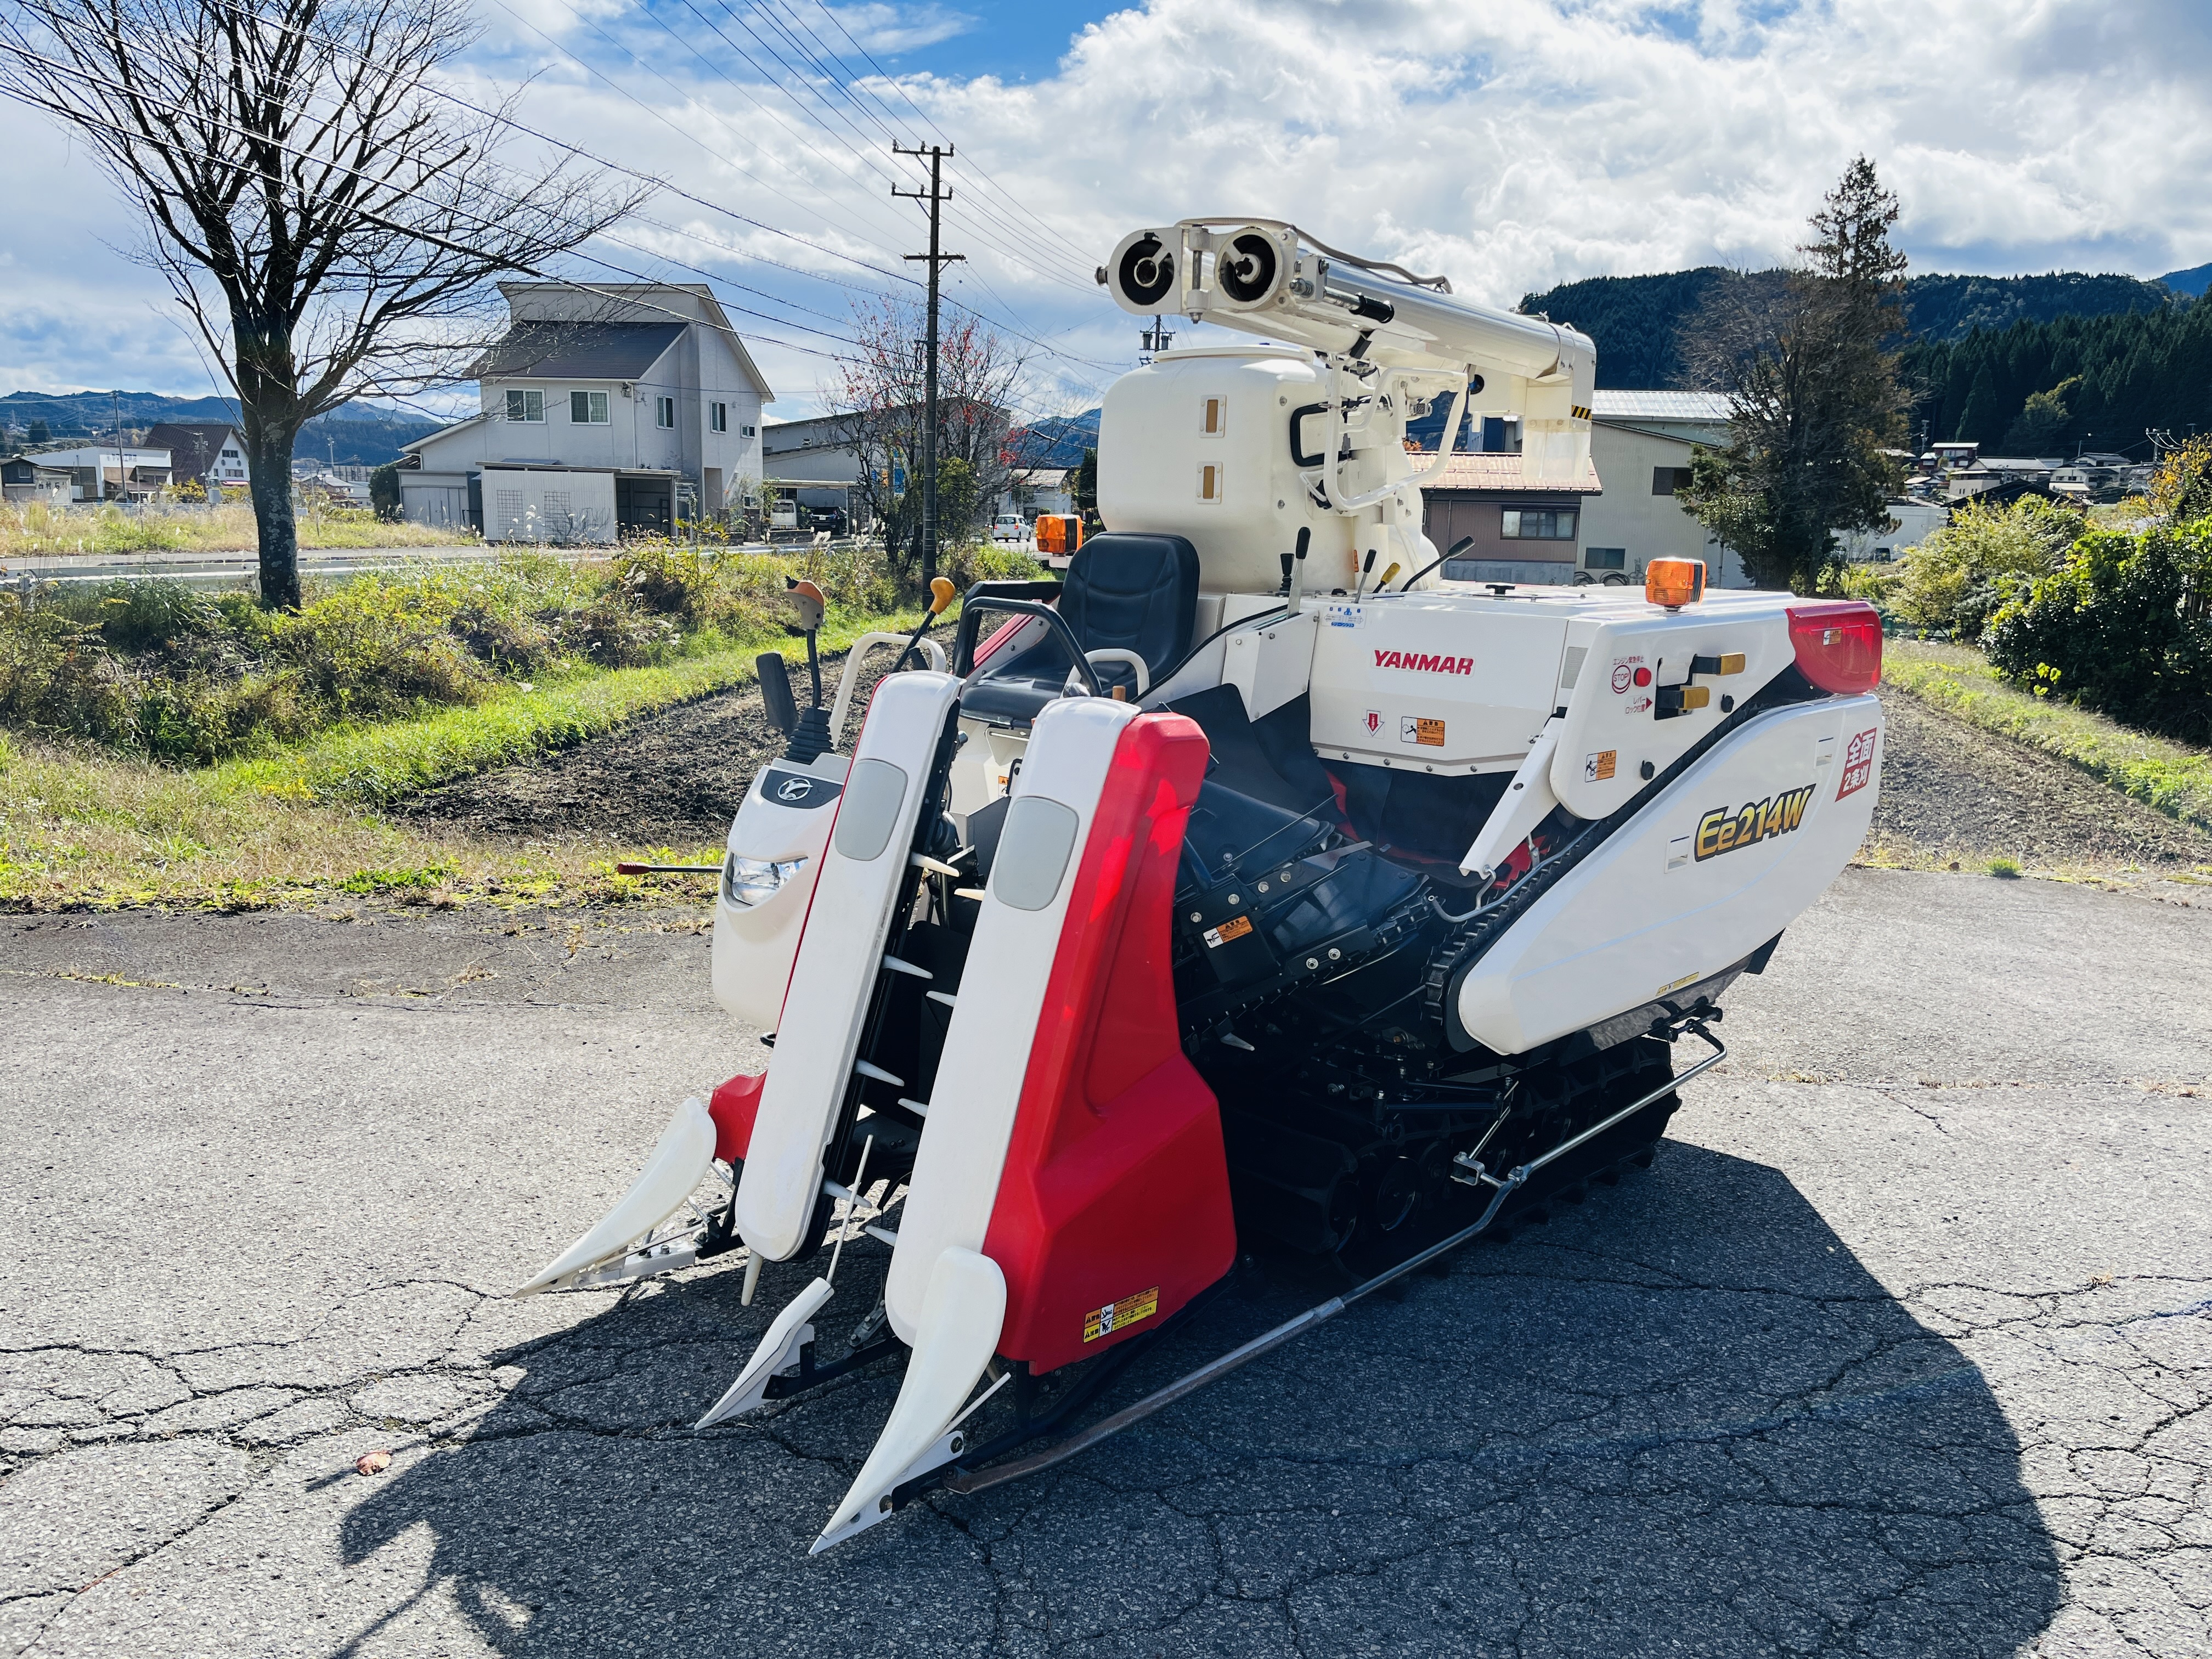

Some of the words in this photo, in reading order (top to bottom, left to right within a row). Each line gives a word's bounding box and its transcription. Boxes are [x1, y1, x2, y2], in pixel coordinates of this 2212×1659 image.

[1374, 650, 1474, 675] YANMAR
[1613, 673, 1629, 682] STOP!
[1633, 696, 1646, 704] レバー
[1846, 731, 1875, 769] 全面
[1843, 763, 1869, 792] 2条刈
[1696, 788, 1812, 858] Ee214W
